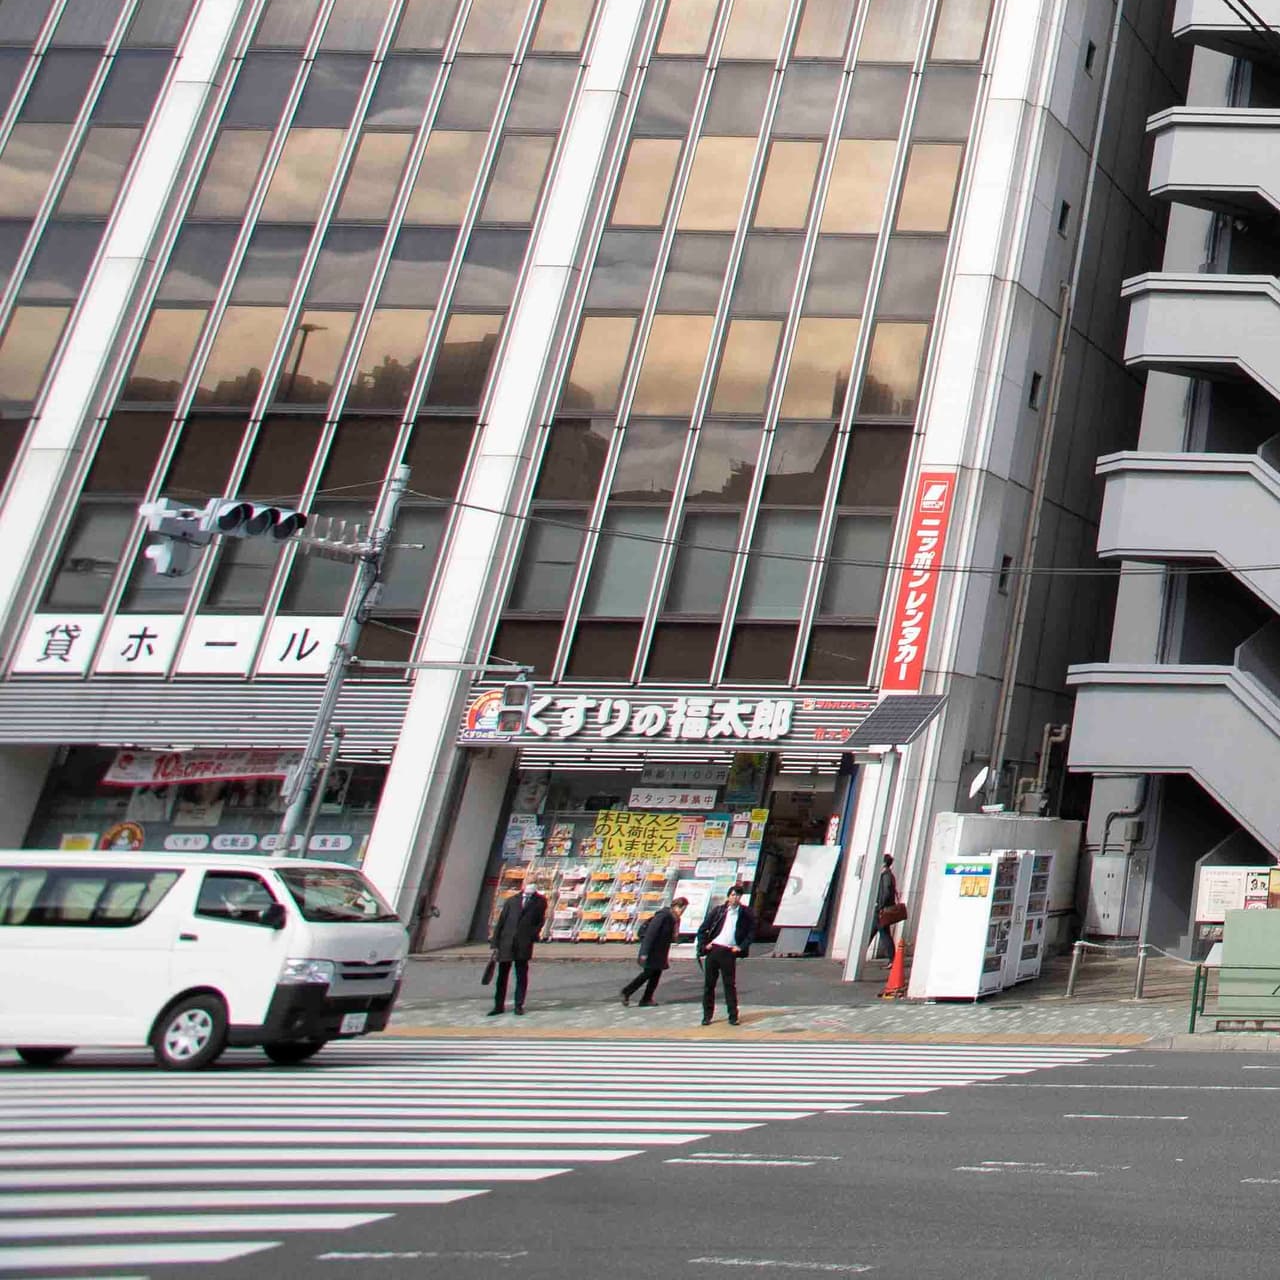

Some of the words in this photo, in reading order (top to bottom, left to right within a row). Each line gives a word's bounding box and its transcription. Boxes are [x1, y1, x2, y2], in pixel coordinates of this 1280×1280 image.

[894, 519, 941, 681] ニッポンレンタカー
[38, 624, 322, 663] 貸ホール
[526, 696, 795, 740] くすりの福太郎
[630, 792, 714, 807] スタッフ募集中
[599, 810, 681, 825] 本日マスク
[594, 823, 678, 840] の入荷はご
[317, 837, 343, 848] 食品
